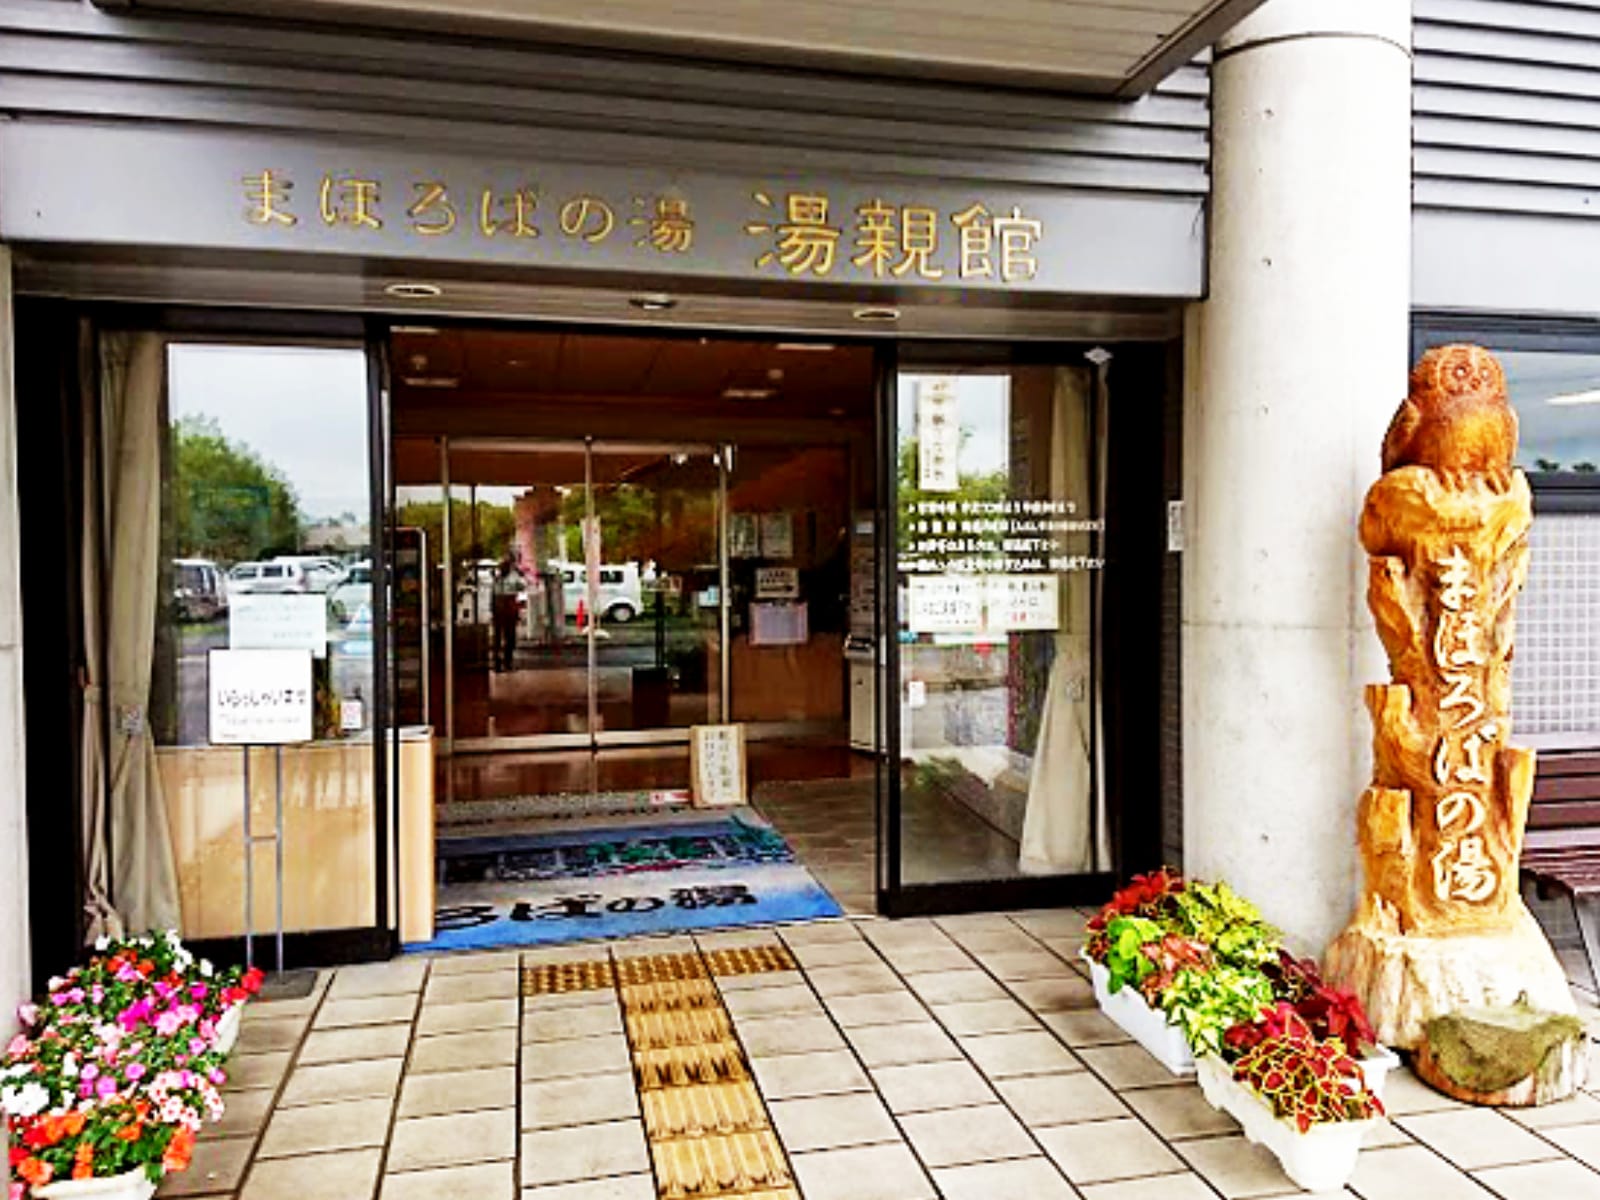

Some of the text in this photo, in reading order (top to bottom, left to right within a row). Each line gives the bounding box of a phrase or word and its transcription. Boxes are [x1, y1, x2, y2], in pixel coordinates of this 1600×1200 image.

[240, 168, 1044, 283] まほろばの湯 湯親館
[1432, 544, 1500, 903] まほろばの湯
